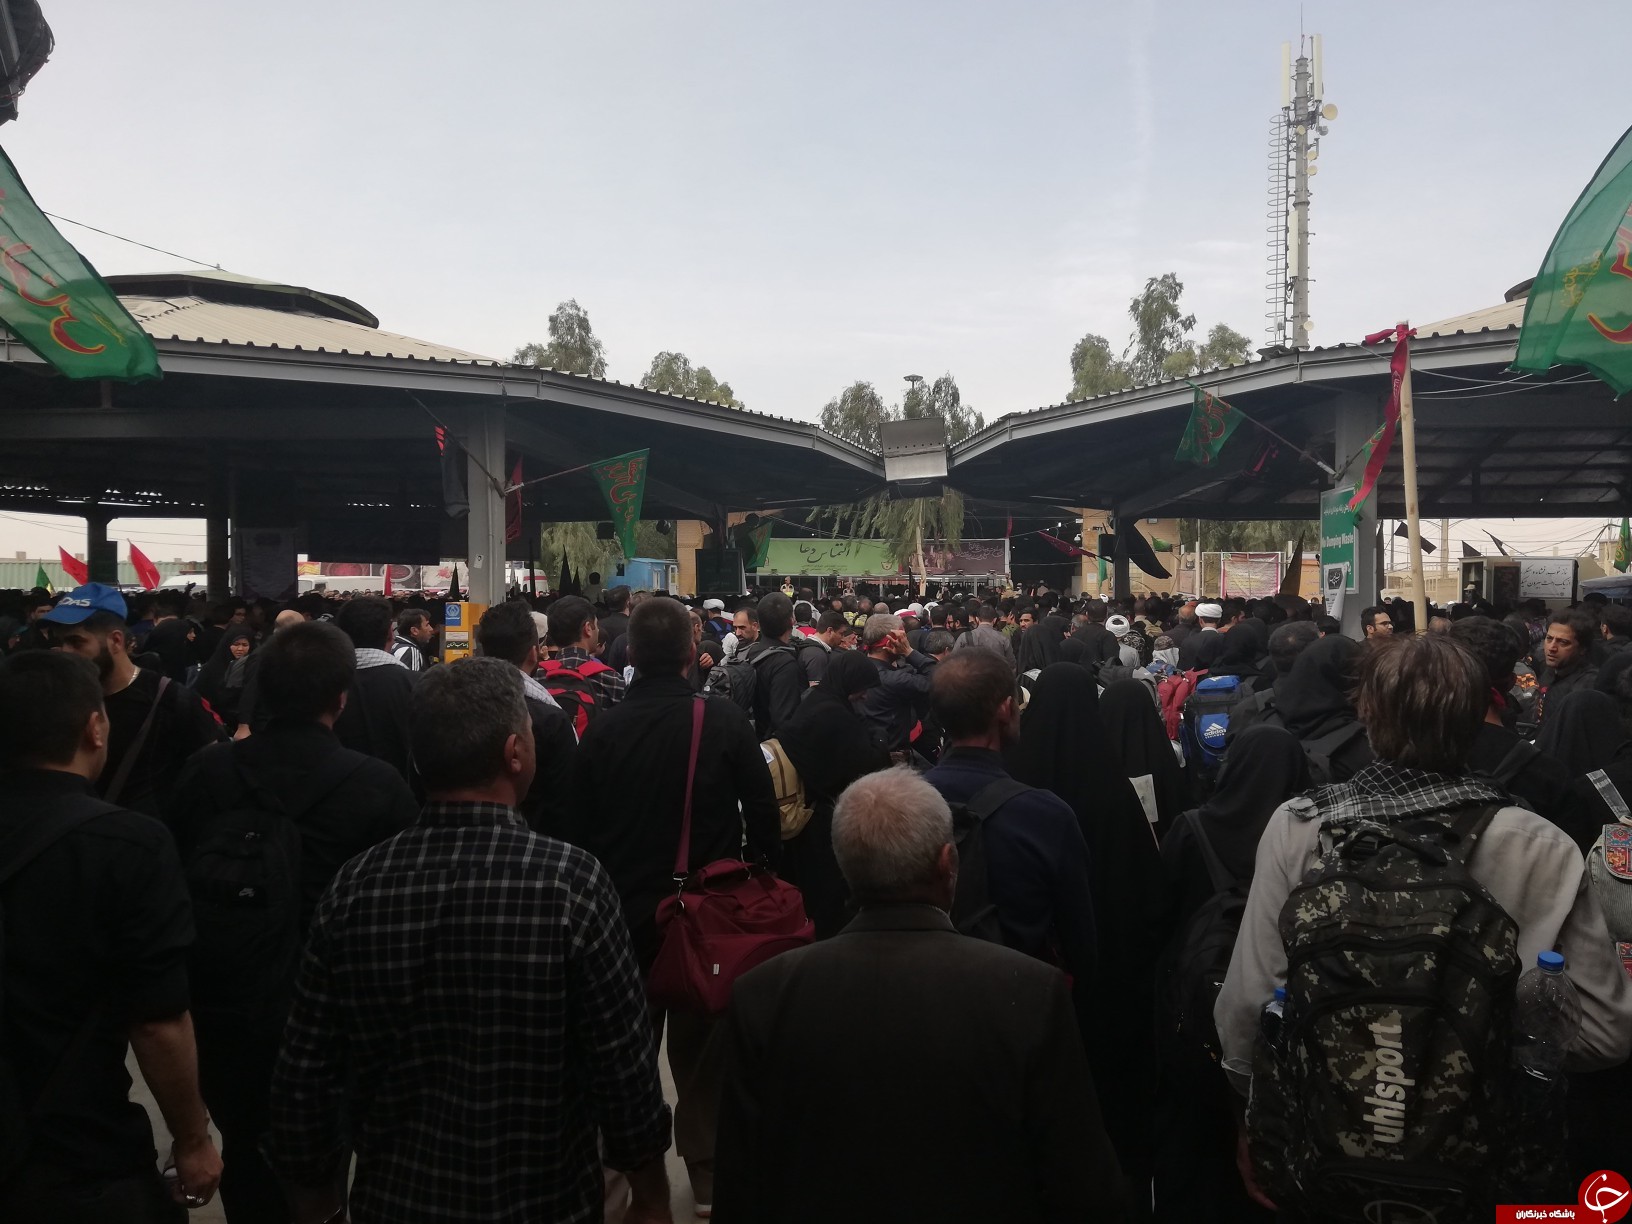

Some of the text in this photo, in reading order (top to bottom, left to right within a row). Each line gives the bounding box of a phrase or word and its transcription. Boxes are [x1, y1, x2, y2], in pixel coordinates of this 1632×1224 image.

[1327, 536, 1341, 549] Dumping
[1342, 532, 1354, 545] Waste
[807, 543, 850, 563] التماس
[1204, 728, 1227, 737] adidas
[1363, 1022, 1416, 1144] uhlsport
